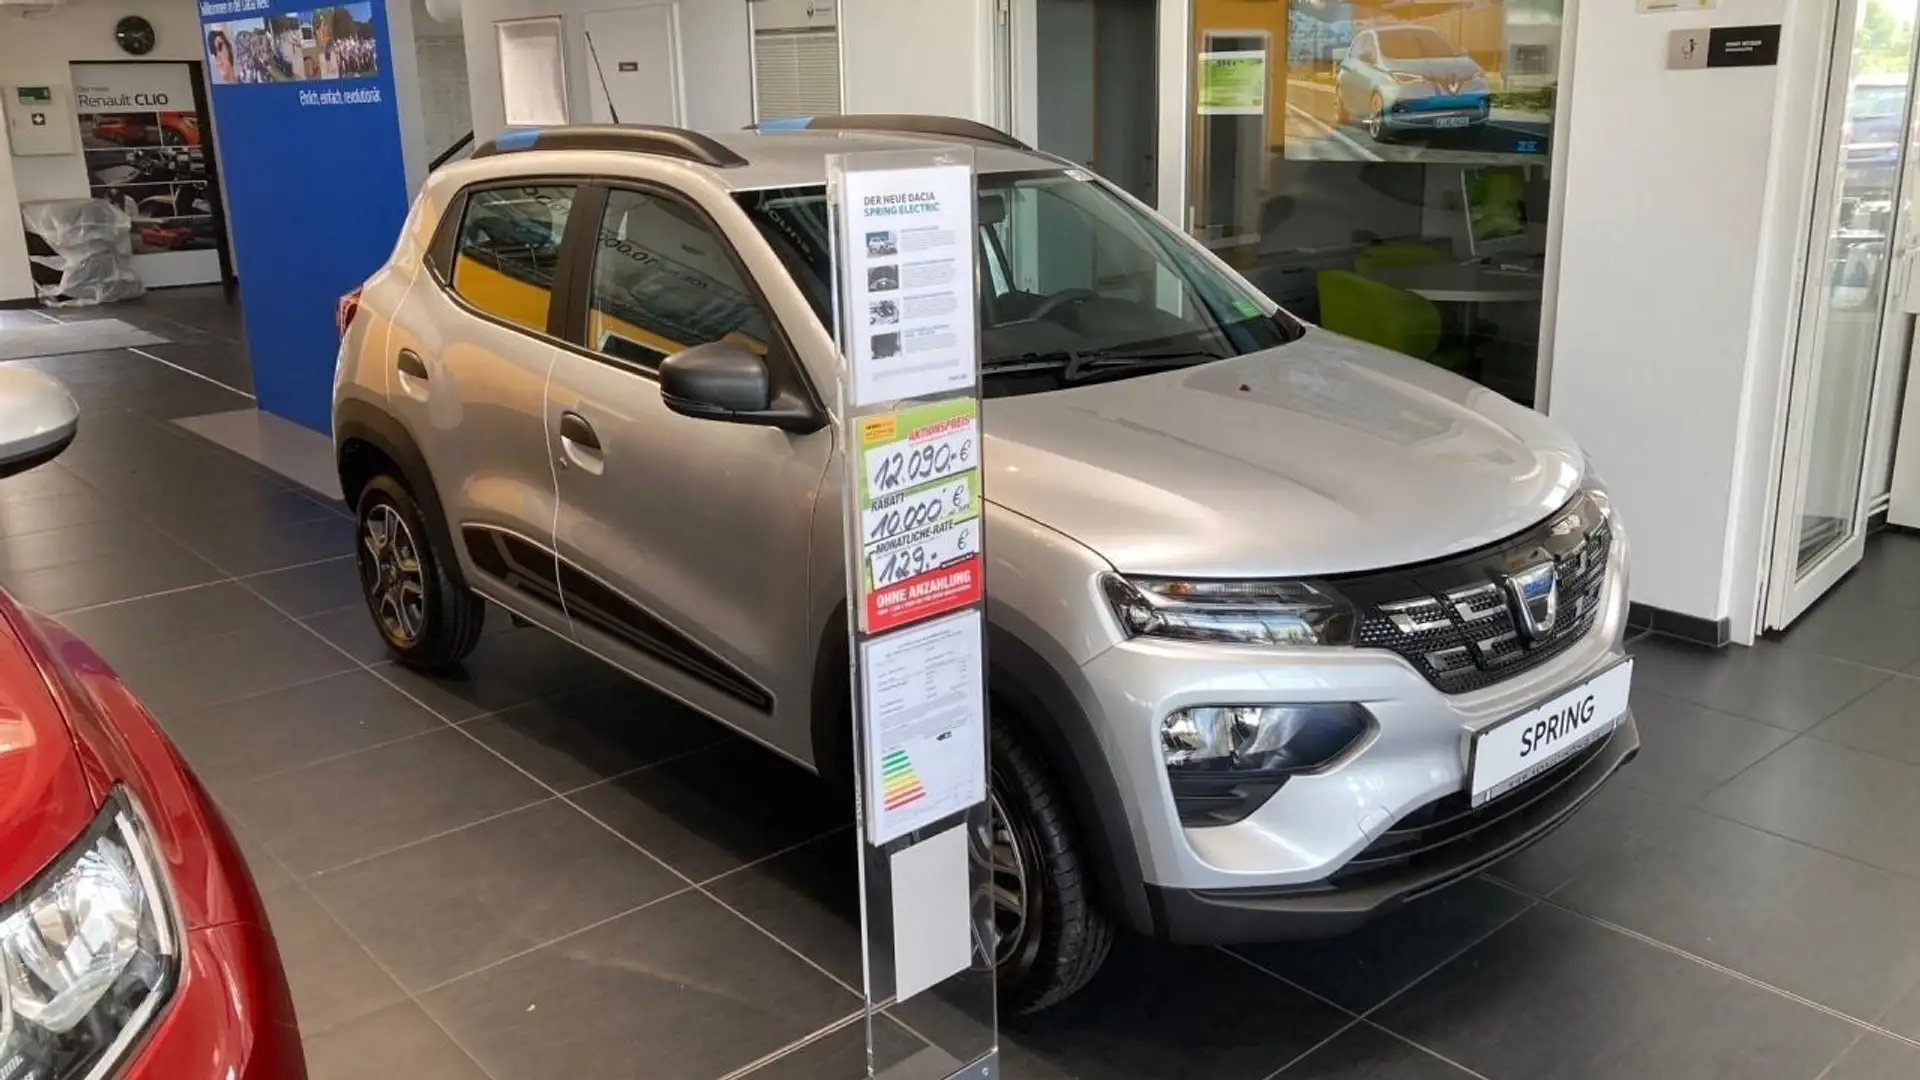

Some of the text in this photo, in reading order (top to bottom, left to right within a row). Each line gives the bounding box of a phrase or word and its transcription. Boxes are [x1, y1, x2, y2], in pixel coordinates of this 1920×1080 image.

[78, 93, 168, 107] Renault CLIO
[864, 192, 936, 206] DER NEUE DACIA
[864, 202, 940, 217] SPRING ELECTRIC
[908, 415, 970, 441] AKTIONSPREIS
[871, 493, 905, 512] RABATT
[876, 588, 908, 609] OHNE
[908, 569, 972, 599] ANZAHLUNG
[1519, 695, 1596, 759] SPRING
